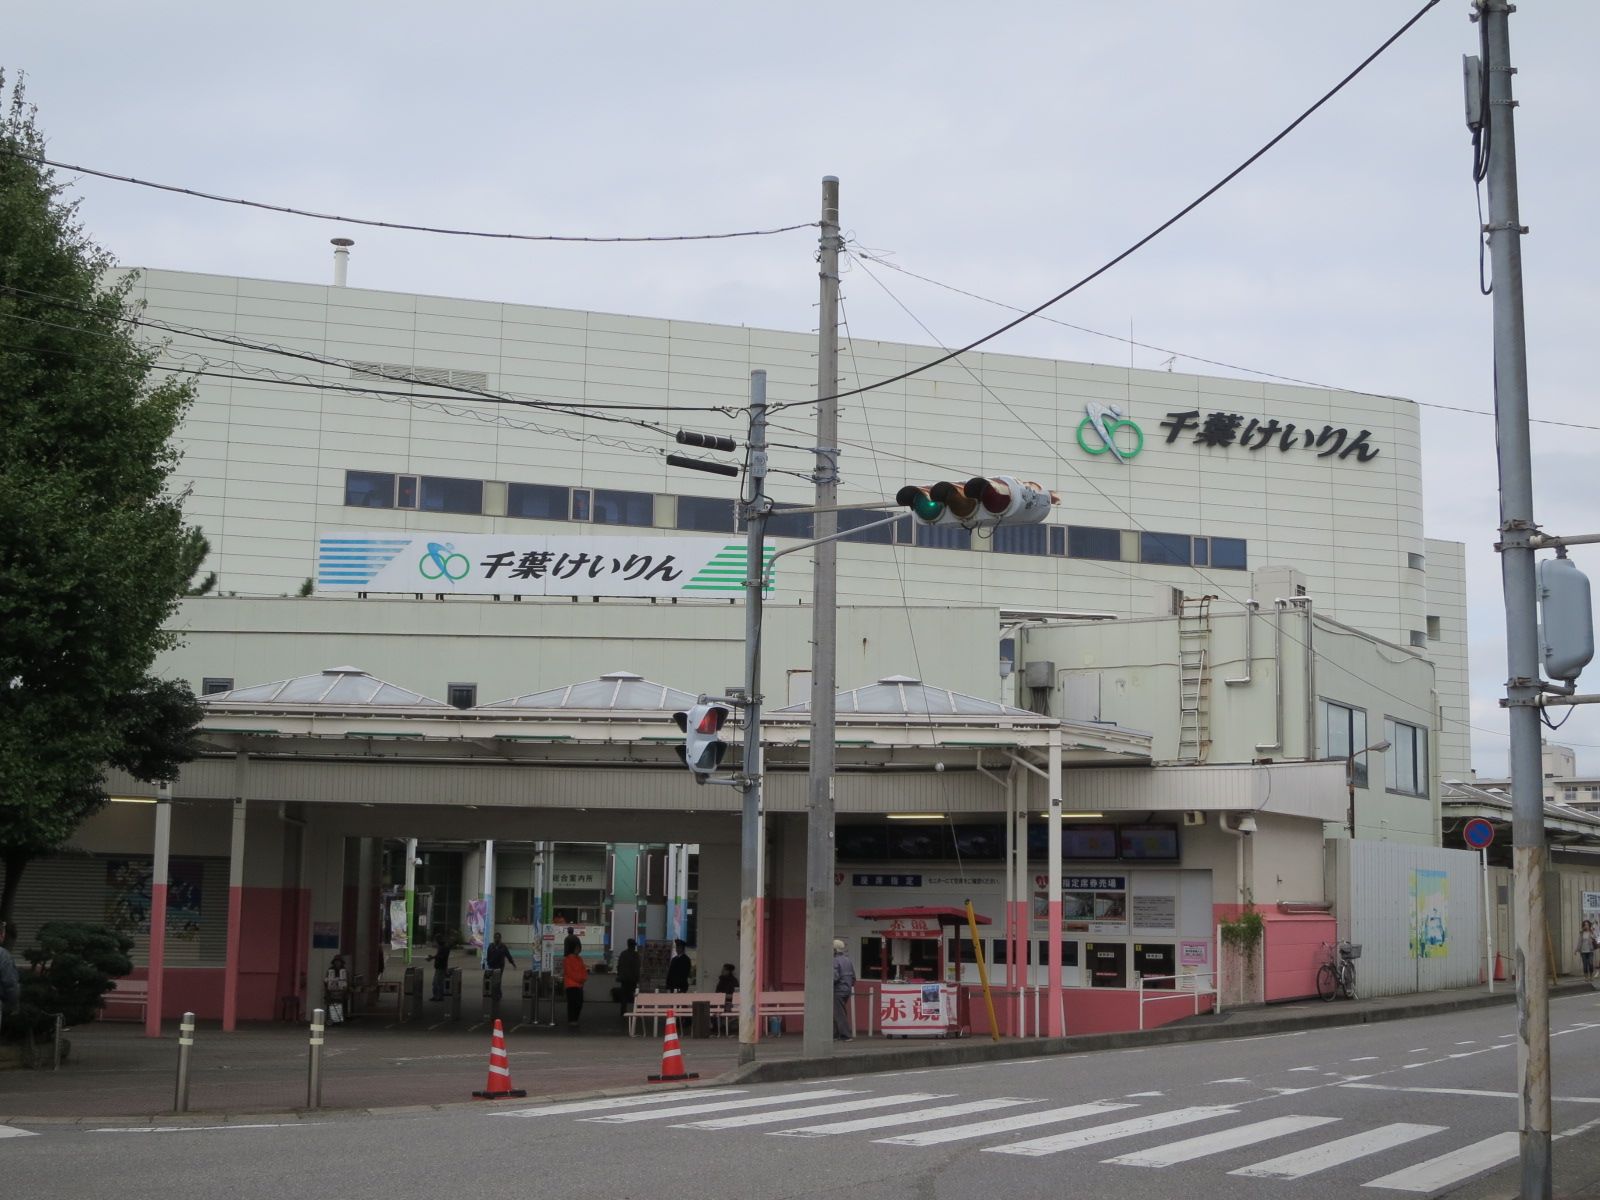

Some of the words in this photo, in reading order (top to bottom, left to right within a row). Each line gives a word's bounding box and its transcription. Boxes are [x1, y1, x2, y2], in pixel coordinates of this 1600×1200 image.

[1159, 409, 1380, 463] 千葉けいりん
[478, 550, 683, 582] 千葉けいりん
[553, 874, 593, 883] 総合案内所
